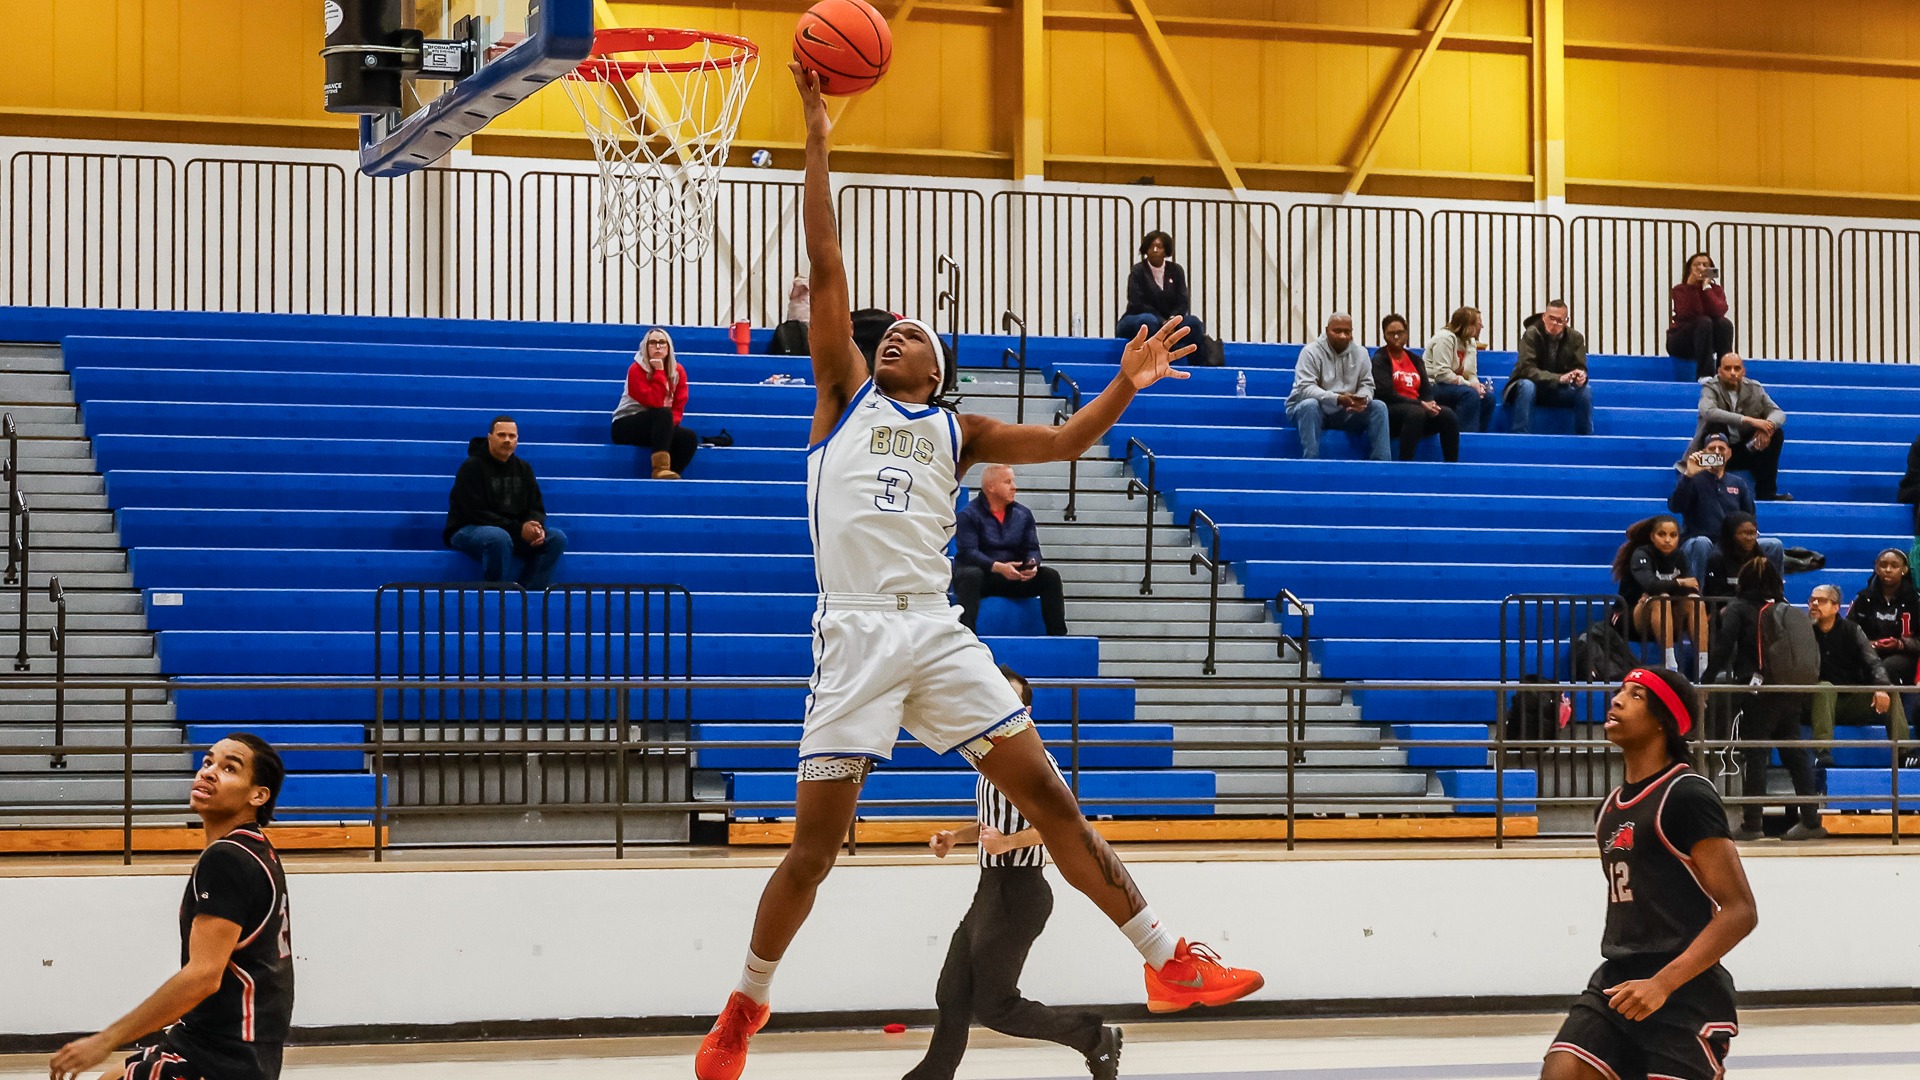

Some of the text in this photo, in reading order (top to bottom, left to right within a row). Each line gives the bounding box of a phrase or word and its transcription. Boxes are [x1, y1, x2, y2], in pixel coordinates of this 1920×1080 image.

[870, 425, 935, 466] BOS
[874, 466, 913, 512] 3
[896, 594, 909, 610] B
[1608, 861, 1634, 903] 12
